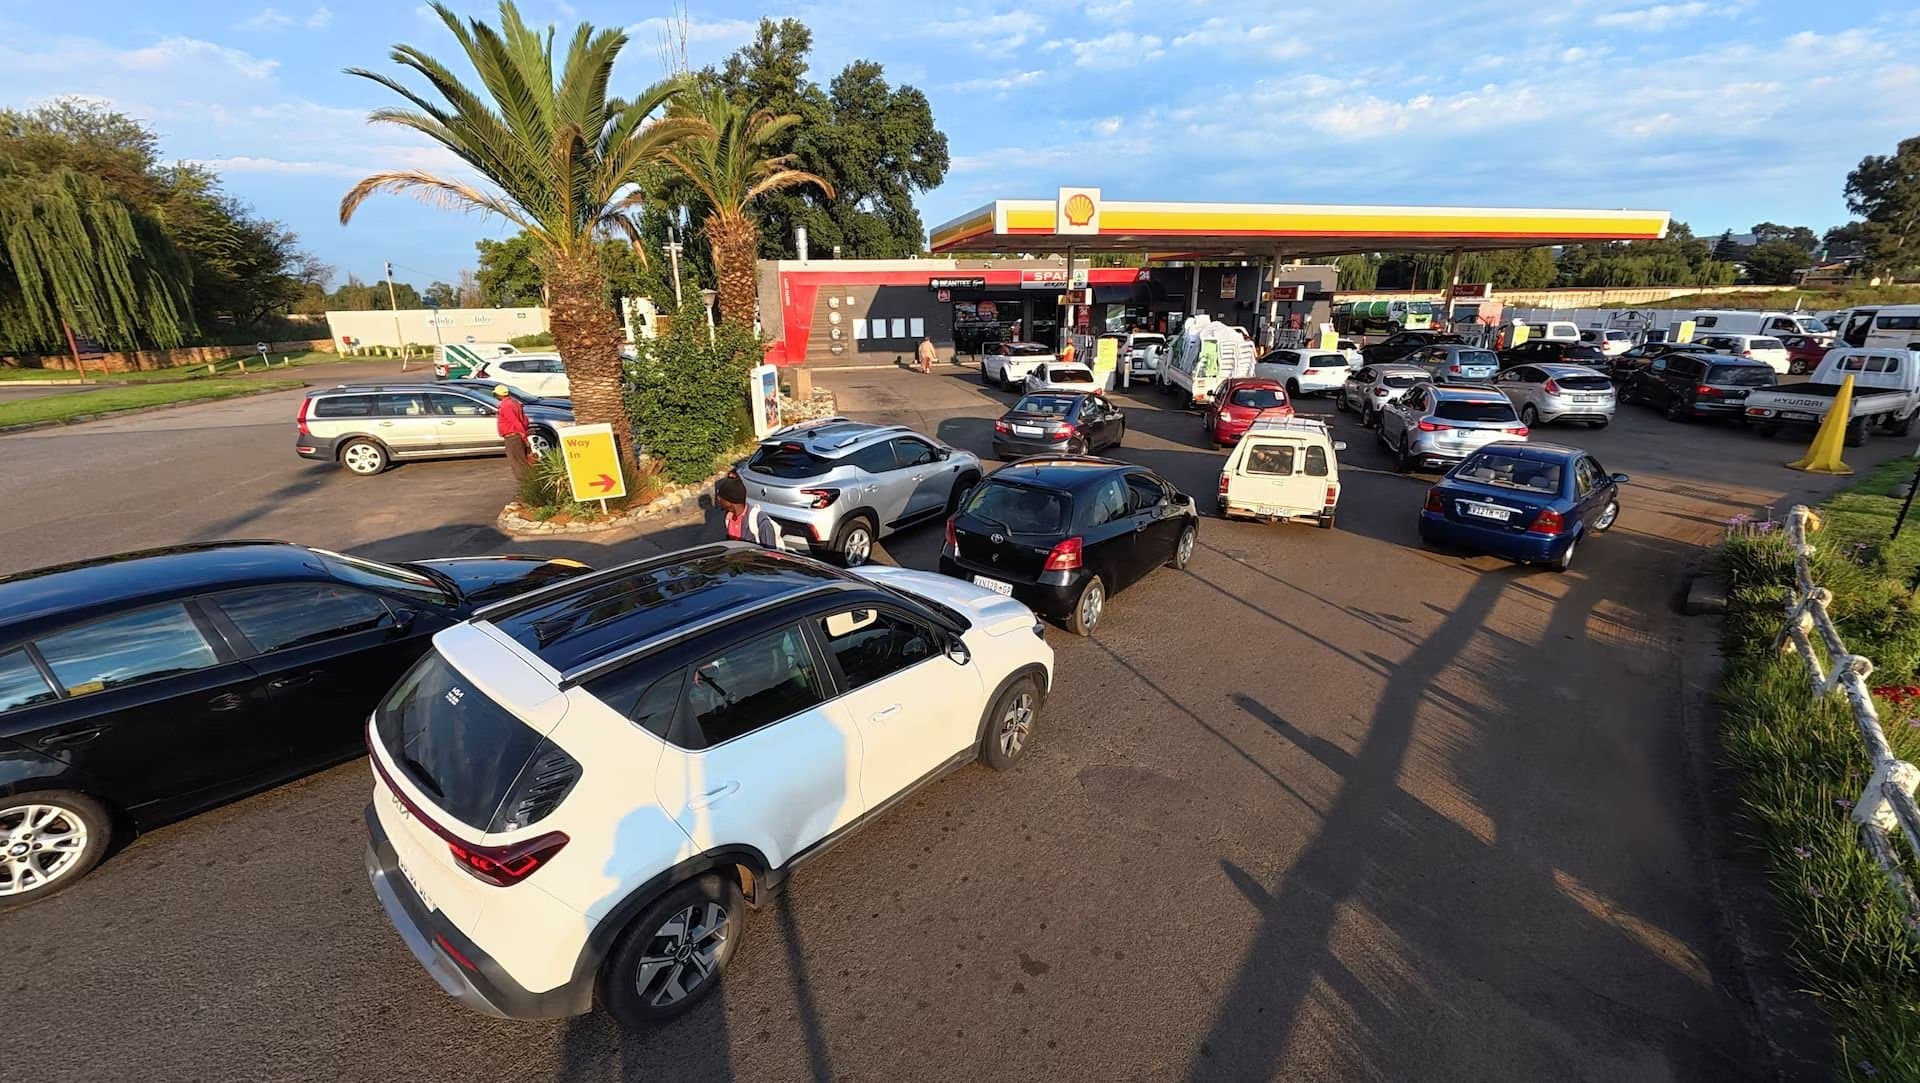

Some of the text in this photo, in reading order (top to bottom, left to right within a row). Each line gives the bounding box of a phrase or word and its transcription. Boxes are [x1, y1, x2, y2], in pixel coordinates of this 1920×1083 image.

[1774, 397, 1824, 407] HYUNDAI
[566, 439, 591, 449] Way
[569, 451, 581, 459] In
